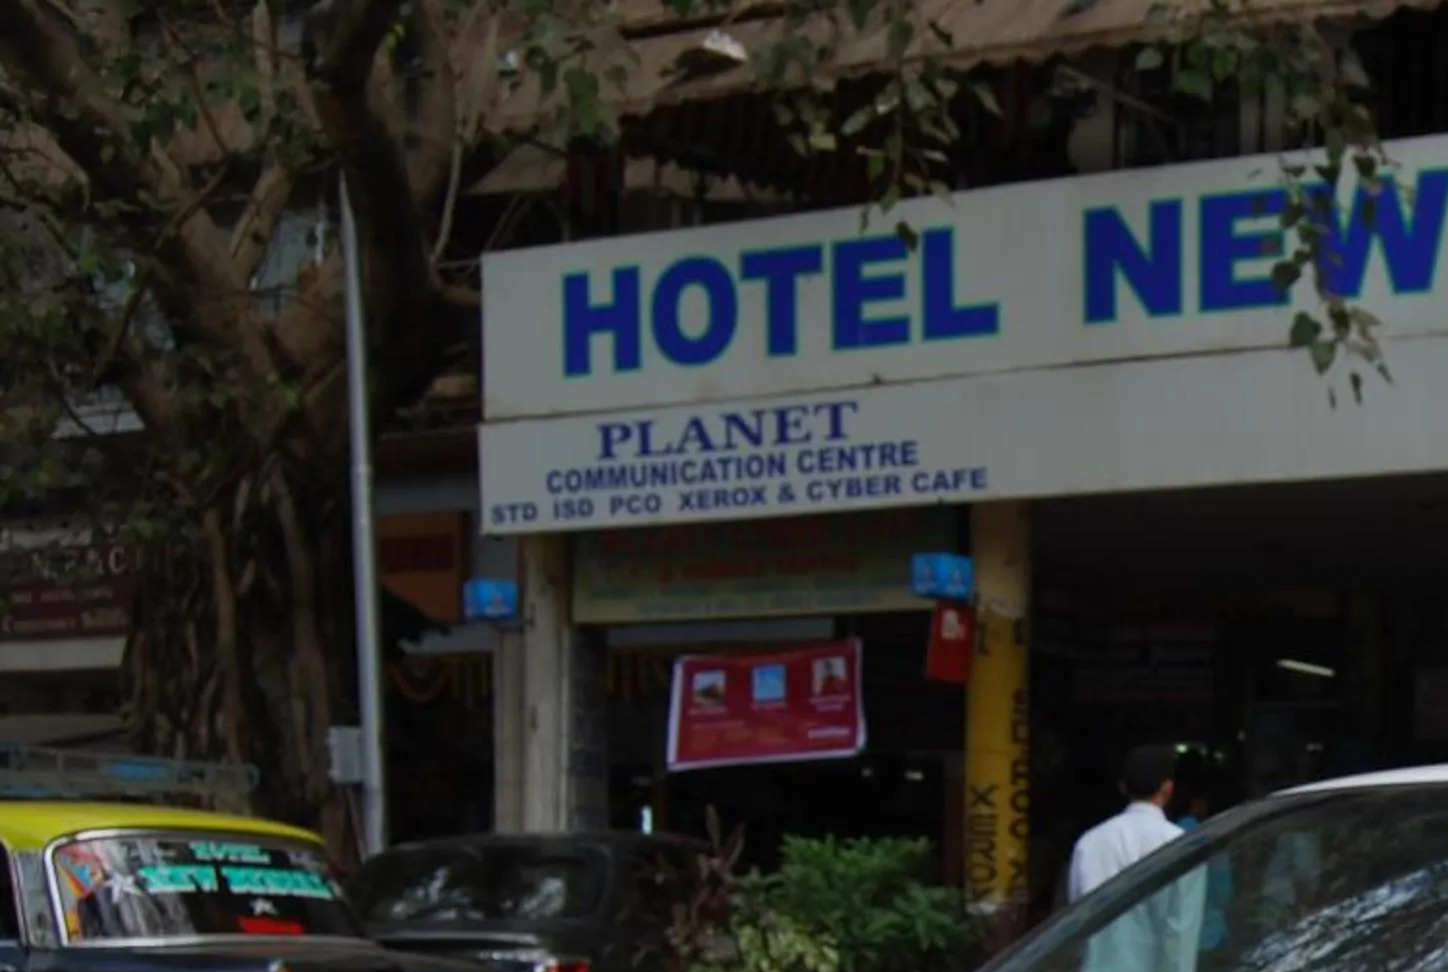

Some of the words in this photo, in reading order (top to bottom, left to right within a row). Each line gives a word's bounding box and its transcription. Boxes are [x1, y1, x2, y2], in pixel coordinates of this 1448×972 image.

[562, 226, 1001, 379] HOTEL
[597, 401, 858, 460] PLANET
[491, 502, 538, 525] STD
[553, 498, 594, 519] ISD
[609, 493, 662, 516] PCO
[678, 485, 767, 512] XEROX
[778, 483, 795, 502] &
[805, 476, 901, 501] CYBER
[911, 467, 988, 493] CAFE
[546, 452, 787, 494] COMMUNICATION
[796, 440, 919, 475] CENTRE
